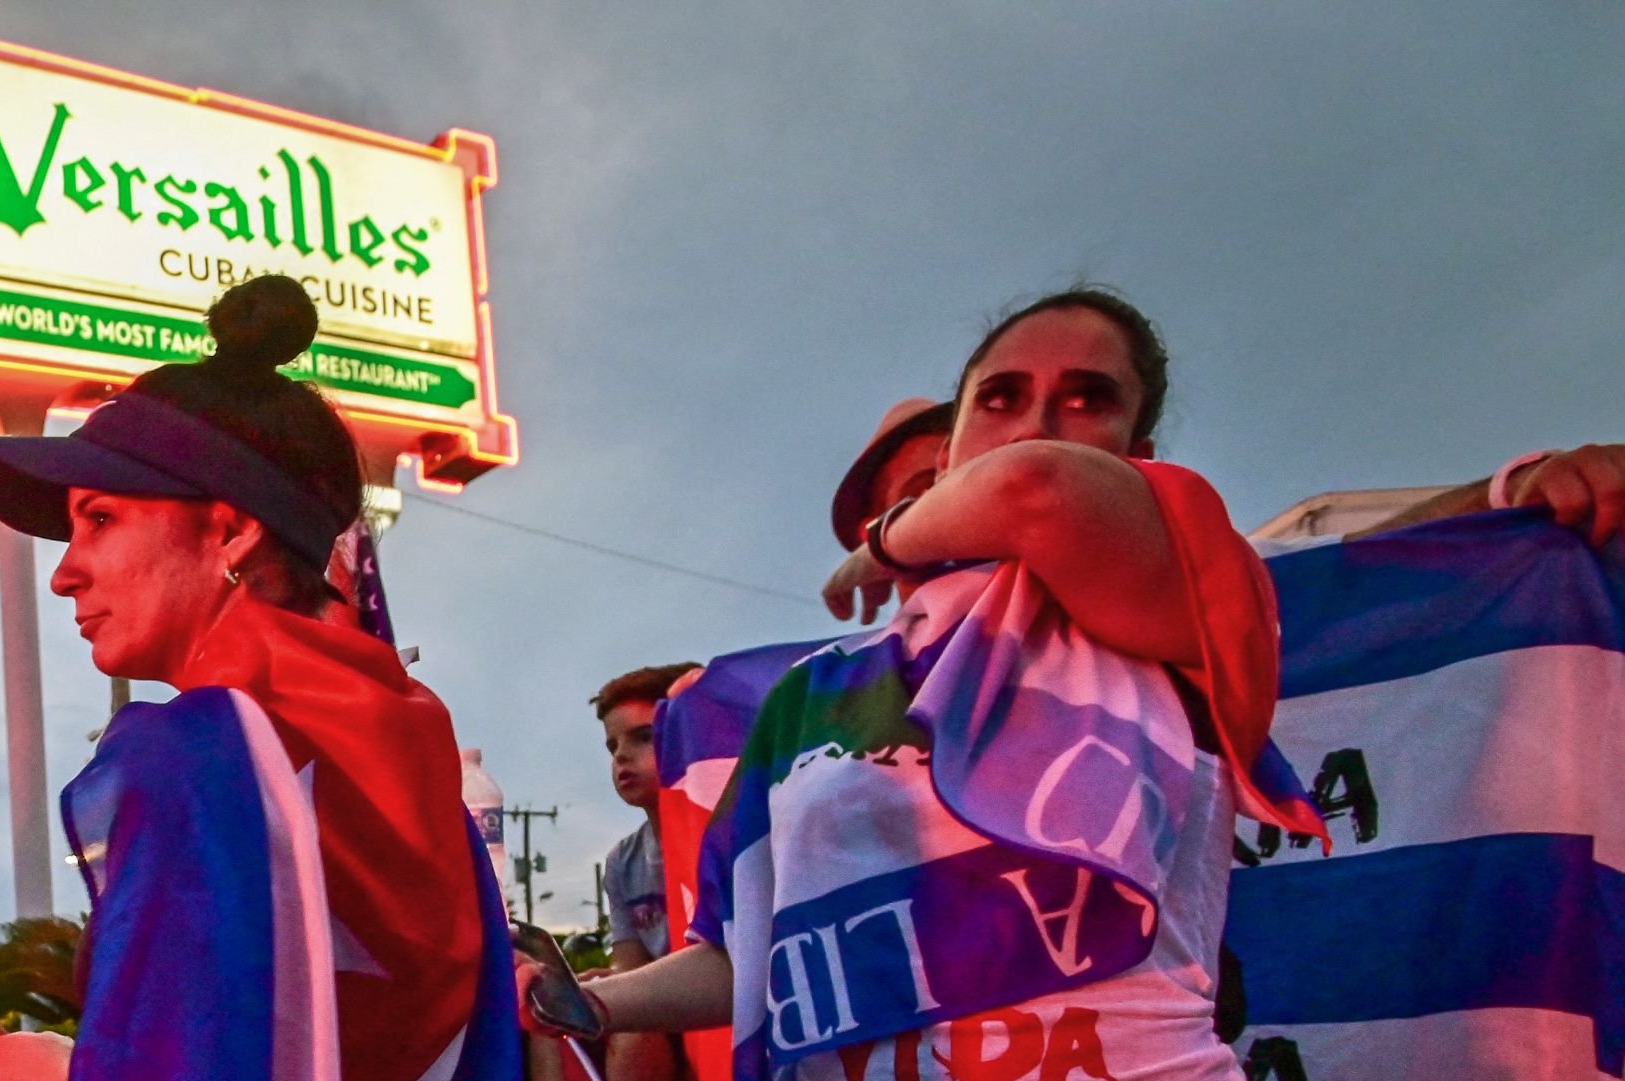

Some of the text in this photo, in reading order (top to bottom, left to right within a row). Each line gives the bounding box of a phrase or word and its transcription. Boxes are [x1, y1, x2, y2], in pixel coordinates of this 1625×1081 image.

[159, 249, 434, 325] CUBA CUISINE
[97, 319, 156, 349] MOST
[161, 328, 218, 357] FAMO
